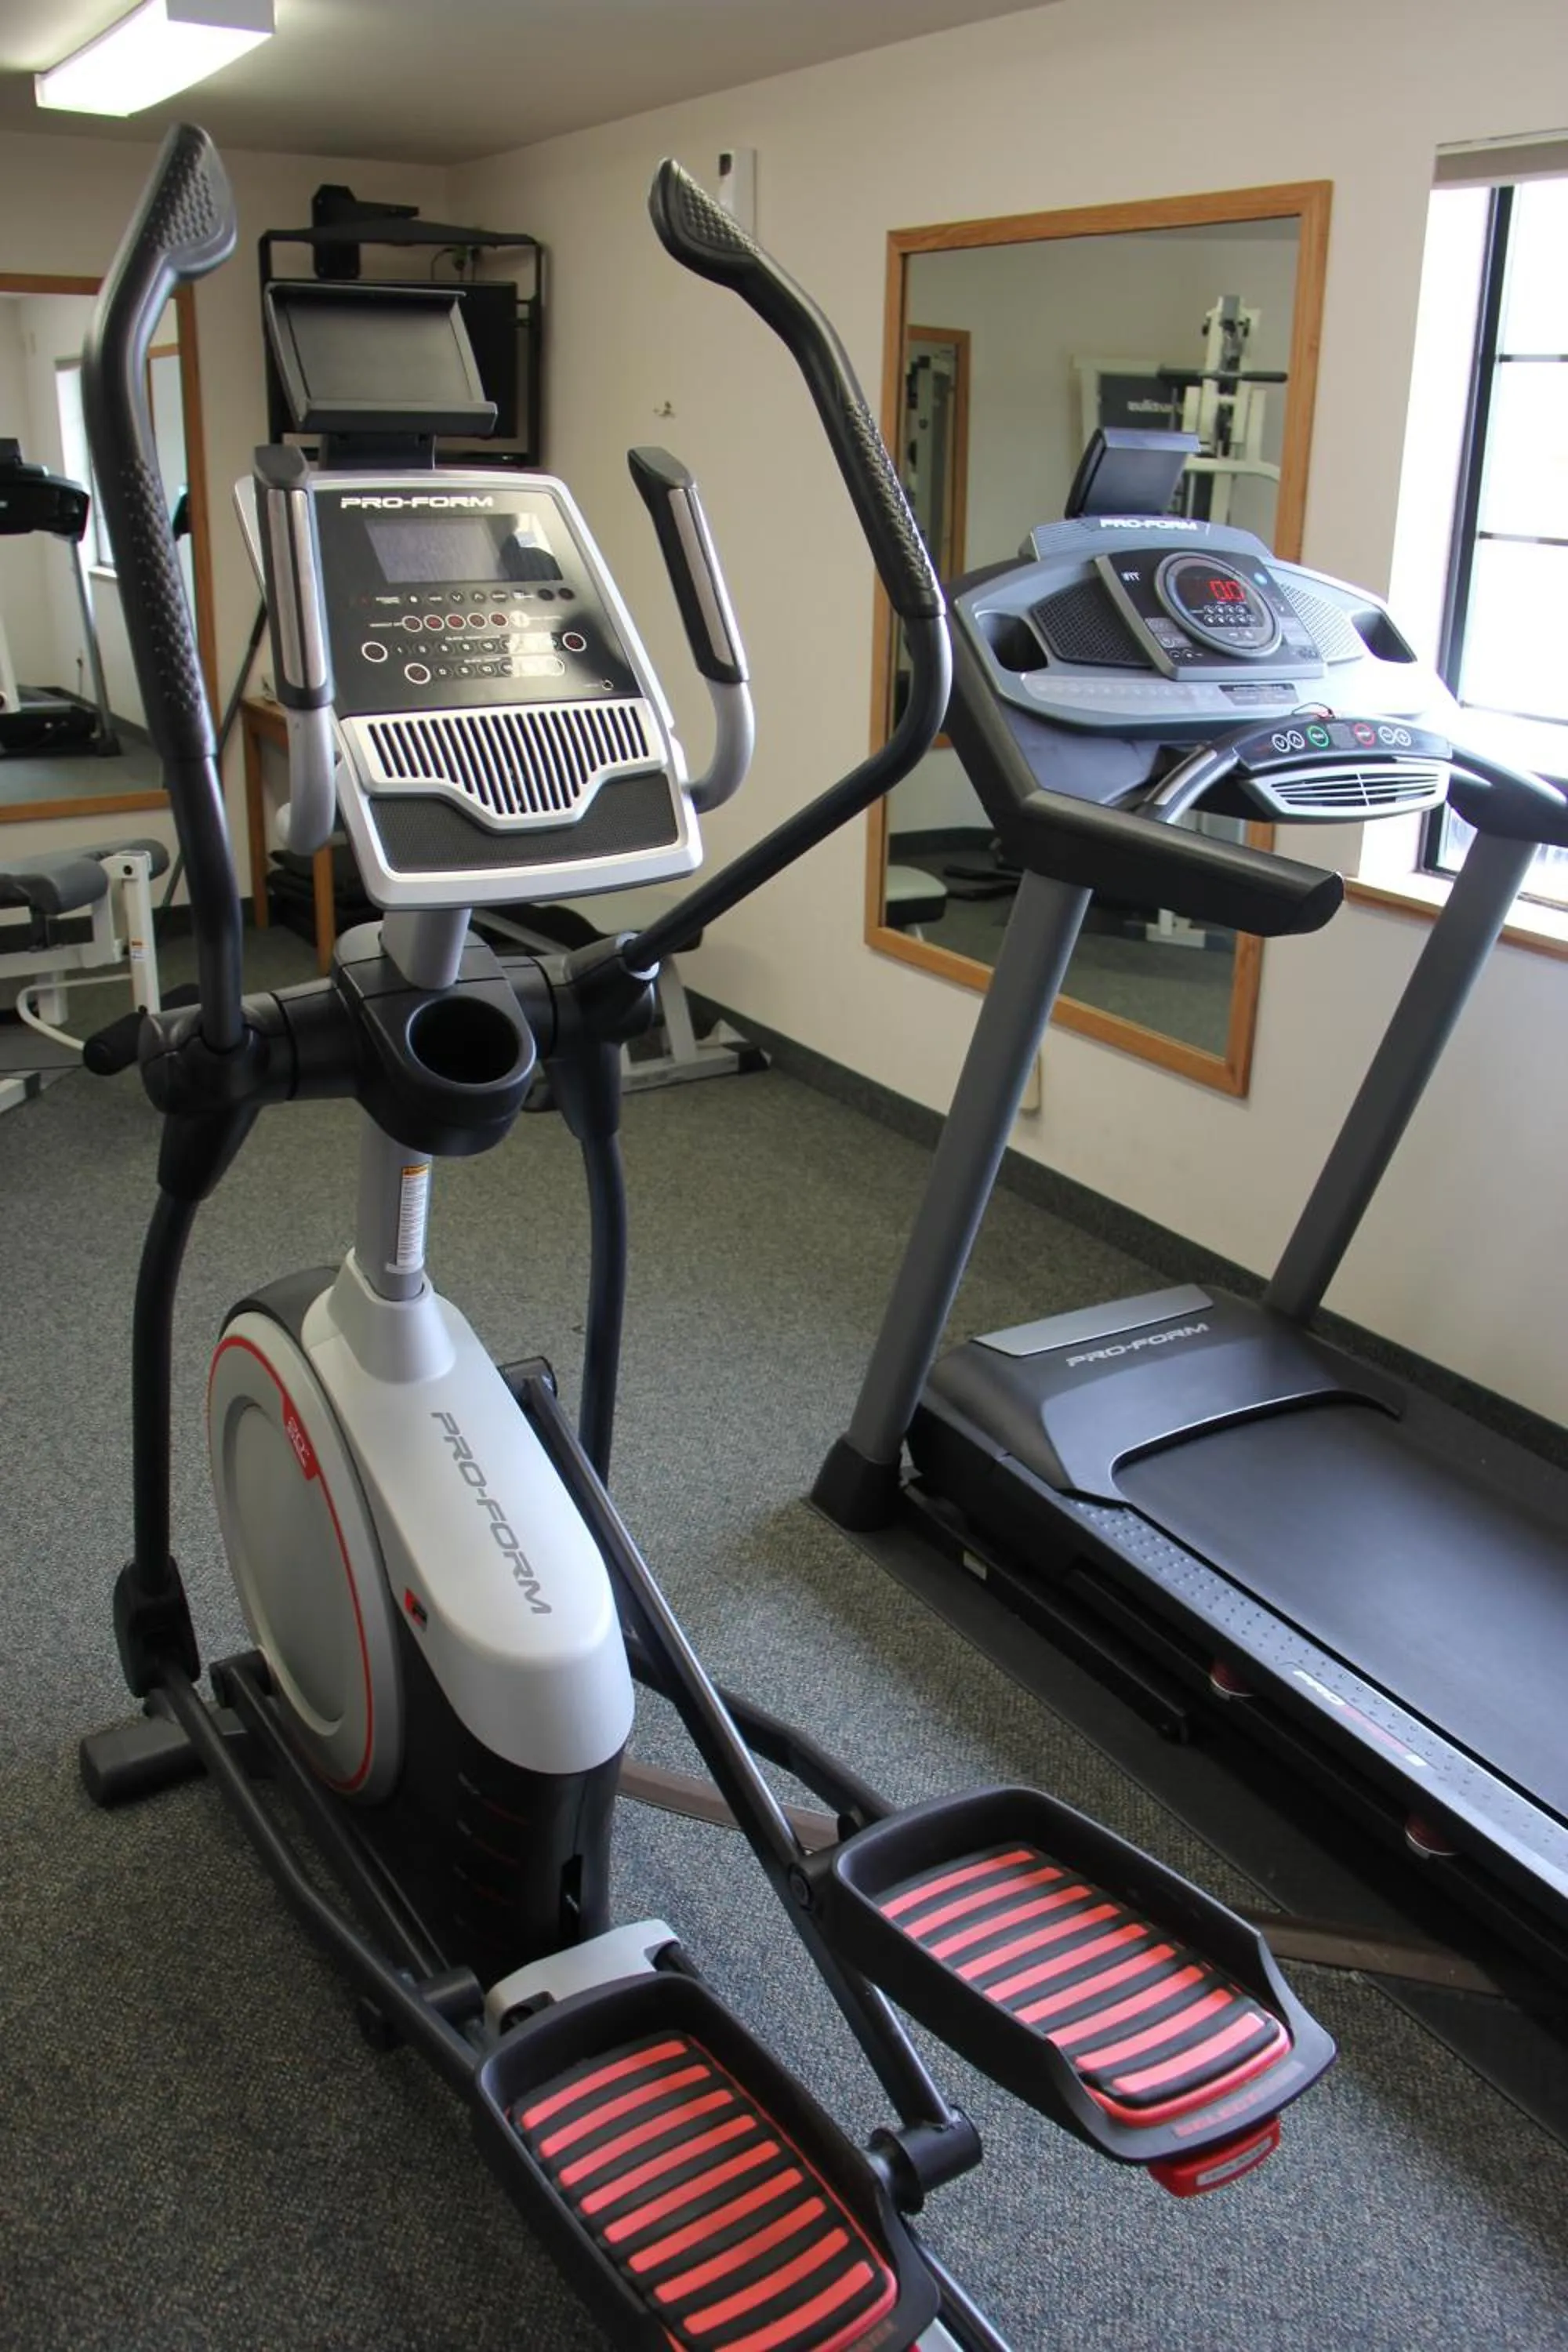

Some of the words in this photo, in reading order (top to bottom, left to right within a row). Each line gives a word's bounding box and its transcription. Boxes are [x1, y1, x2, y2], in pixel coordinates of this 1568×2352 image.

[340, 496, 493, 509] PRO-FORM
[1099, 517, 1198, 531] PRO-FORM
[1066, 1323, 1210, 1367] PRO-FORM
[431, 1412, 552, 1613] PRO-FORM
